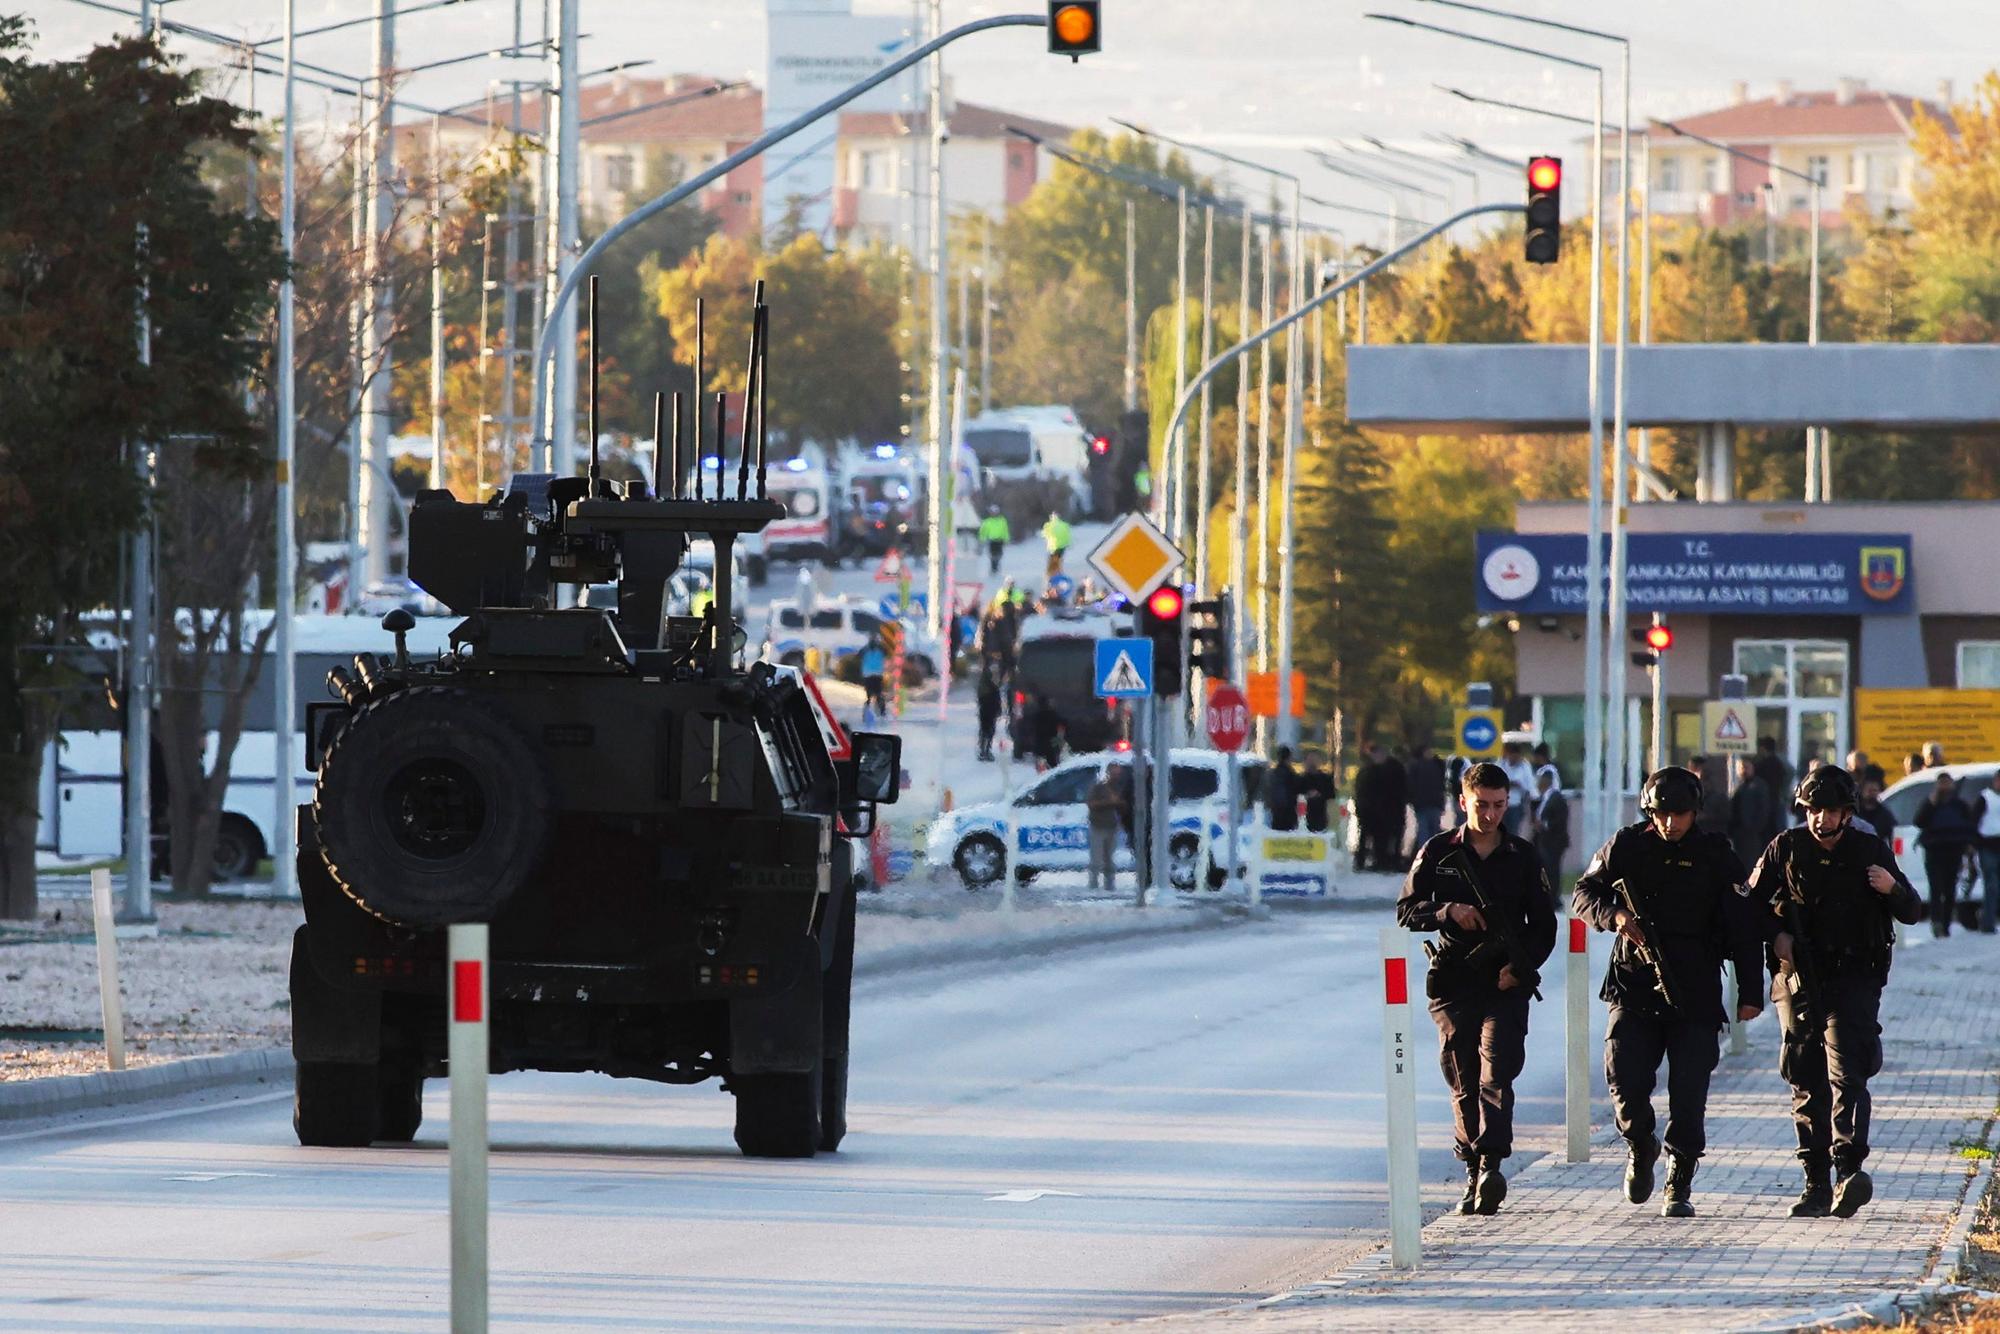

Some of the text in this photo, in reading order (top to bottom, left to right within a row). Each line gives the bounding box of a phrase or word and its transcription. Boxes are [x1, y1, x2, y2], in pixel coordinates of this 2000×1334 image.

[1553, 565, 1709, 579] KAHANKAZAN
[1208, 705, 1245, 733] DUR
[1395, 1032, 1403, 1074] KGM
